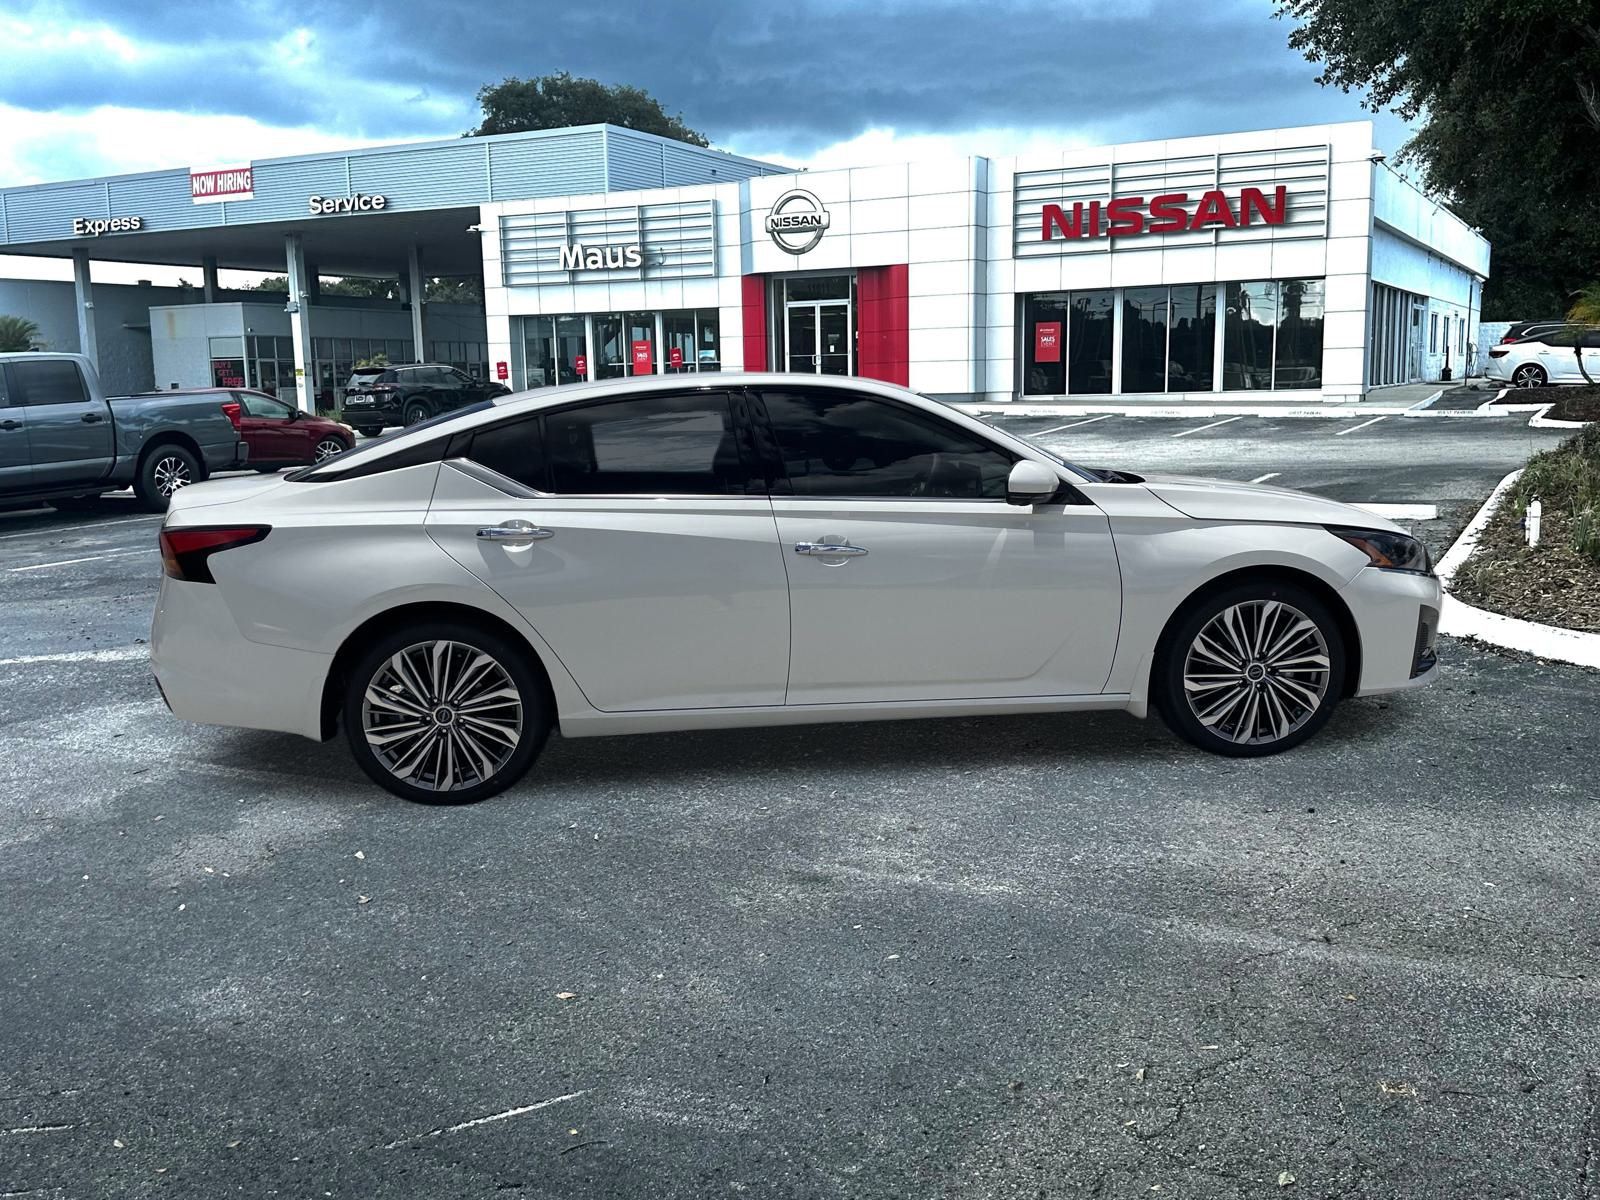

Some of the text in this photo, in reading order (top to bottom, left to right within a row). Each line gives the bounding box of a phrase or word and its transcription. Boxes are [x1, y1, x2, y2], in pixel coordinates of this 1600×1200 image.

[192, 170, 251, 195] NOW HIRING
[308, 193, 385, 216] Service
[1042, 185, 1287, 241] NISSAN
[72, 214, 141, 237] Express
[770, 214, 822, 229] NISSAN
[560, 243, 642, 270] Maus
[223, 377, 244, 387] FREE
